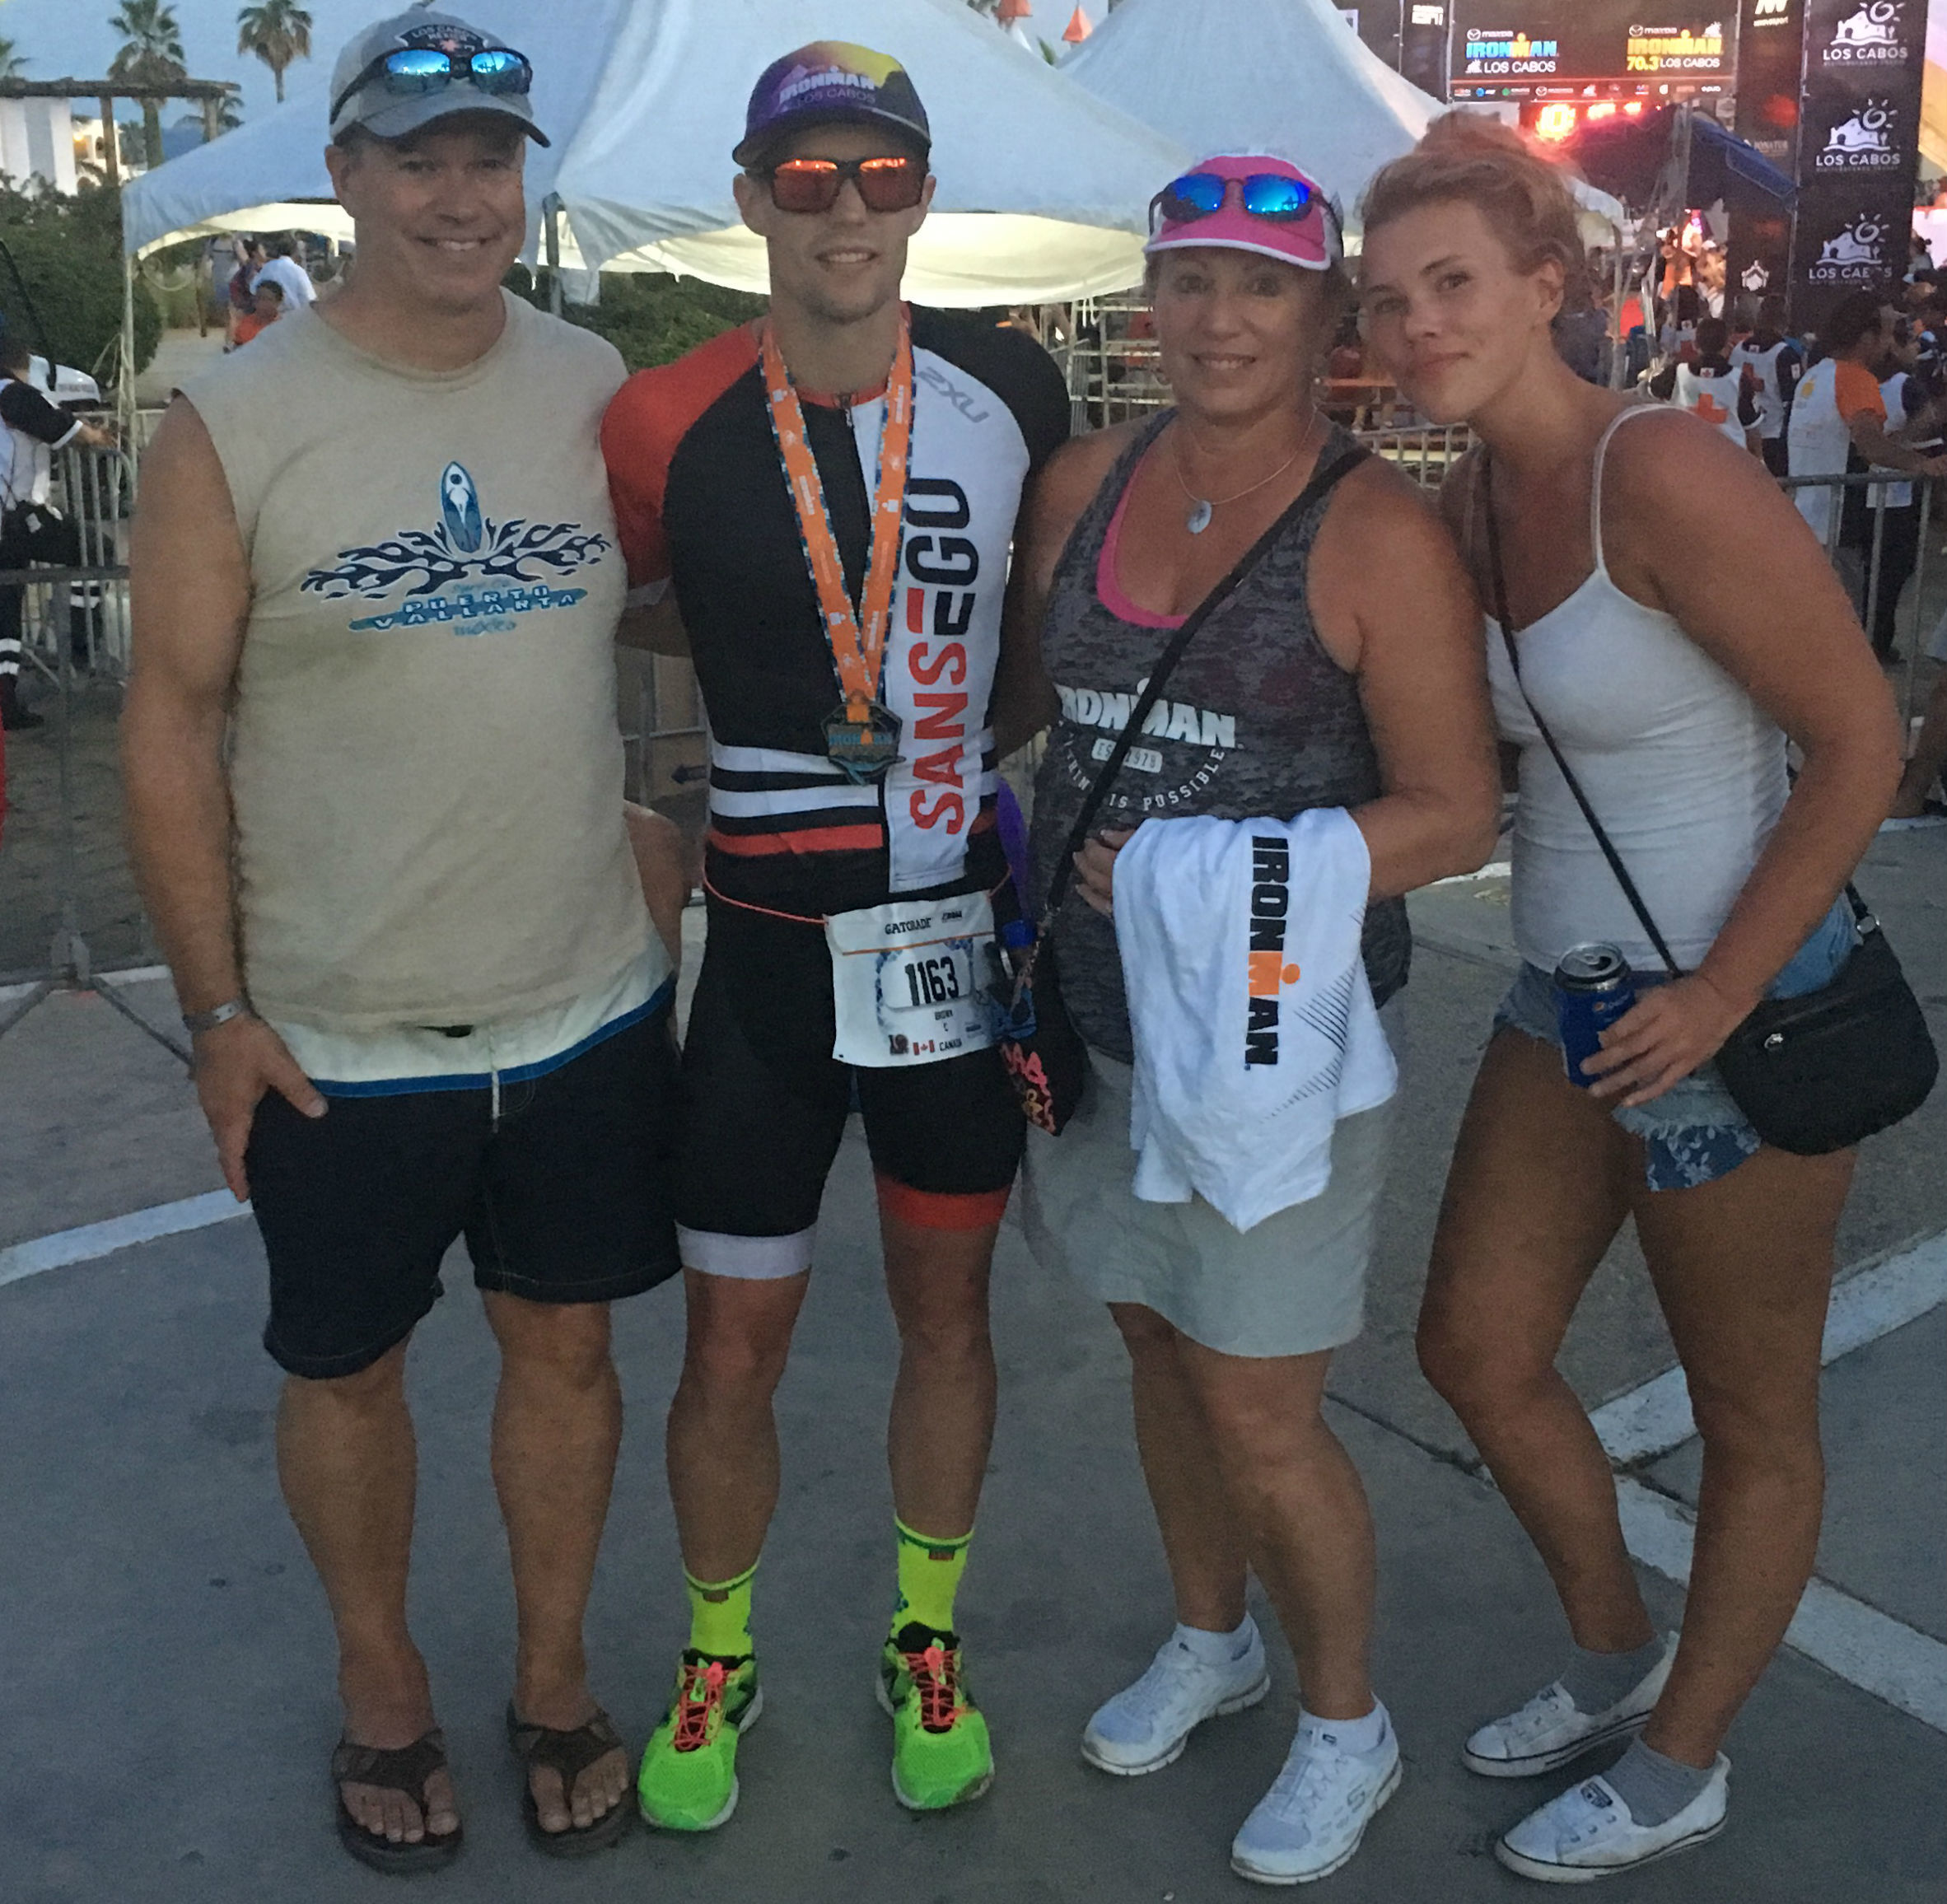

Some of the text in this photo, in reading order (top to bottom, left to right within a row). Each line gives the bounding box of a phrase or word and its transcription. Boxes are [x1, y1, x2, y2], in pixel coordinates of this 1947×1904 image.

[1466, 33, 1557, 58] IRONMAN
[1627, 30, 1722, 55] IRONMAN
[1823, 47, 1907, 60] LOS CABOS
[1484, 61, 1556, 72] LOS CABOS
[1627, 56, 1720, 71] 70.3 LOS CABOS
[827, 88, 876, 104] CABOS
[1816, 153, 1900, 166] LOS CABOS
[1809, 267, 1893, 279] LOS CABS
[917, 366, 990, 423] 2XU
[404, 585, 550, 614] PUERTO
[1109, 793, 1128, 809] IS
[1142, 748, 1225, 811] POSSIBLE
[1245, 835, 1300, 1066] IRONMAN
[904, 955, 960, 1007] 1163
